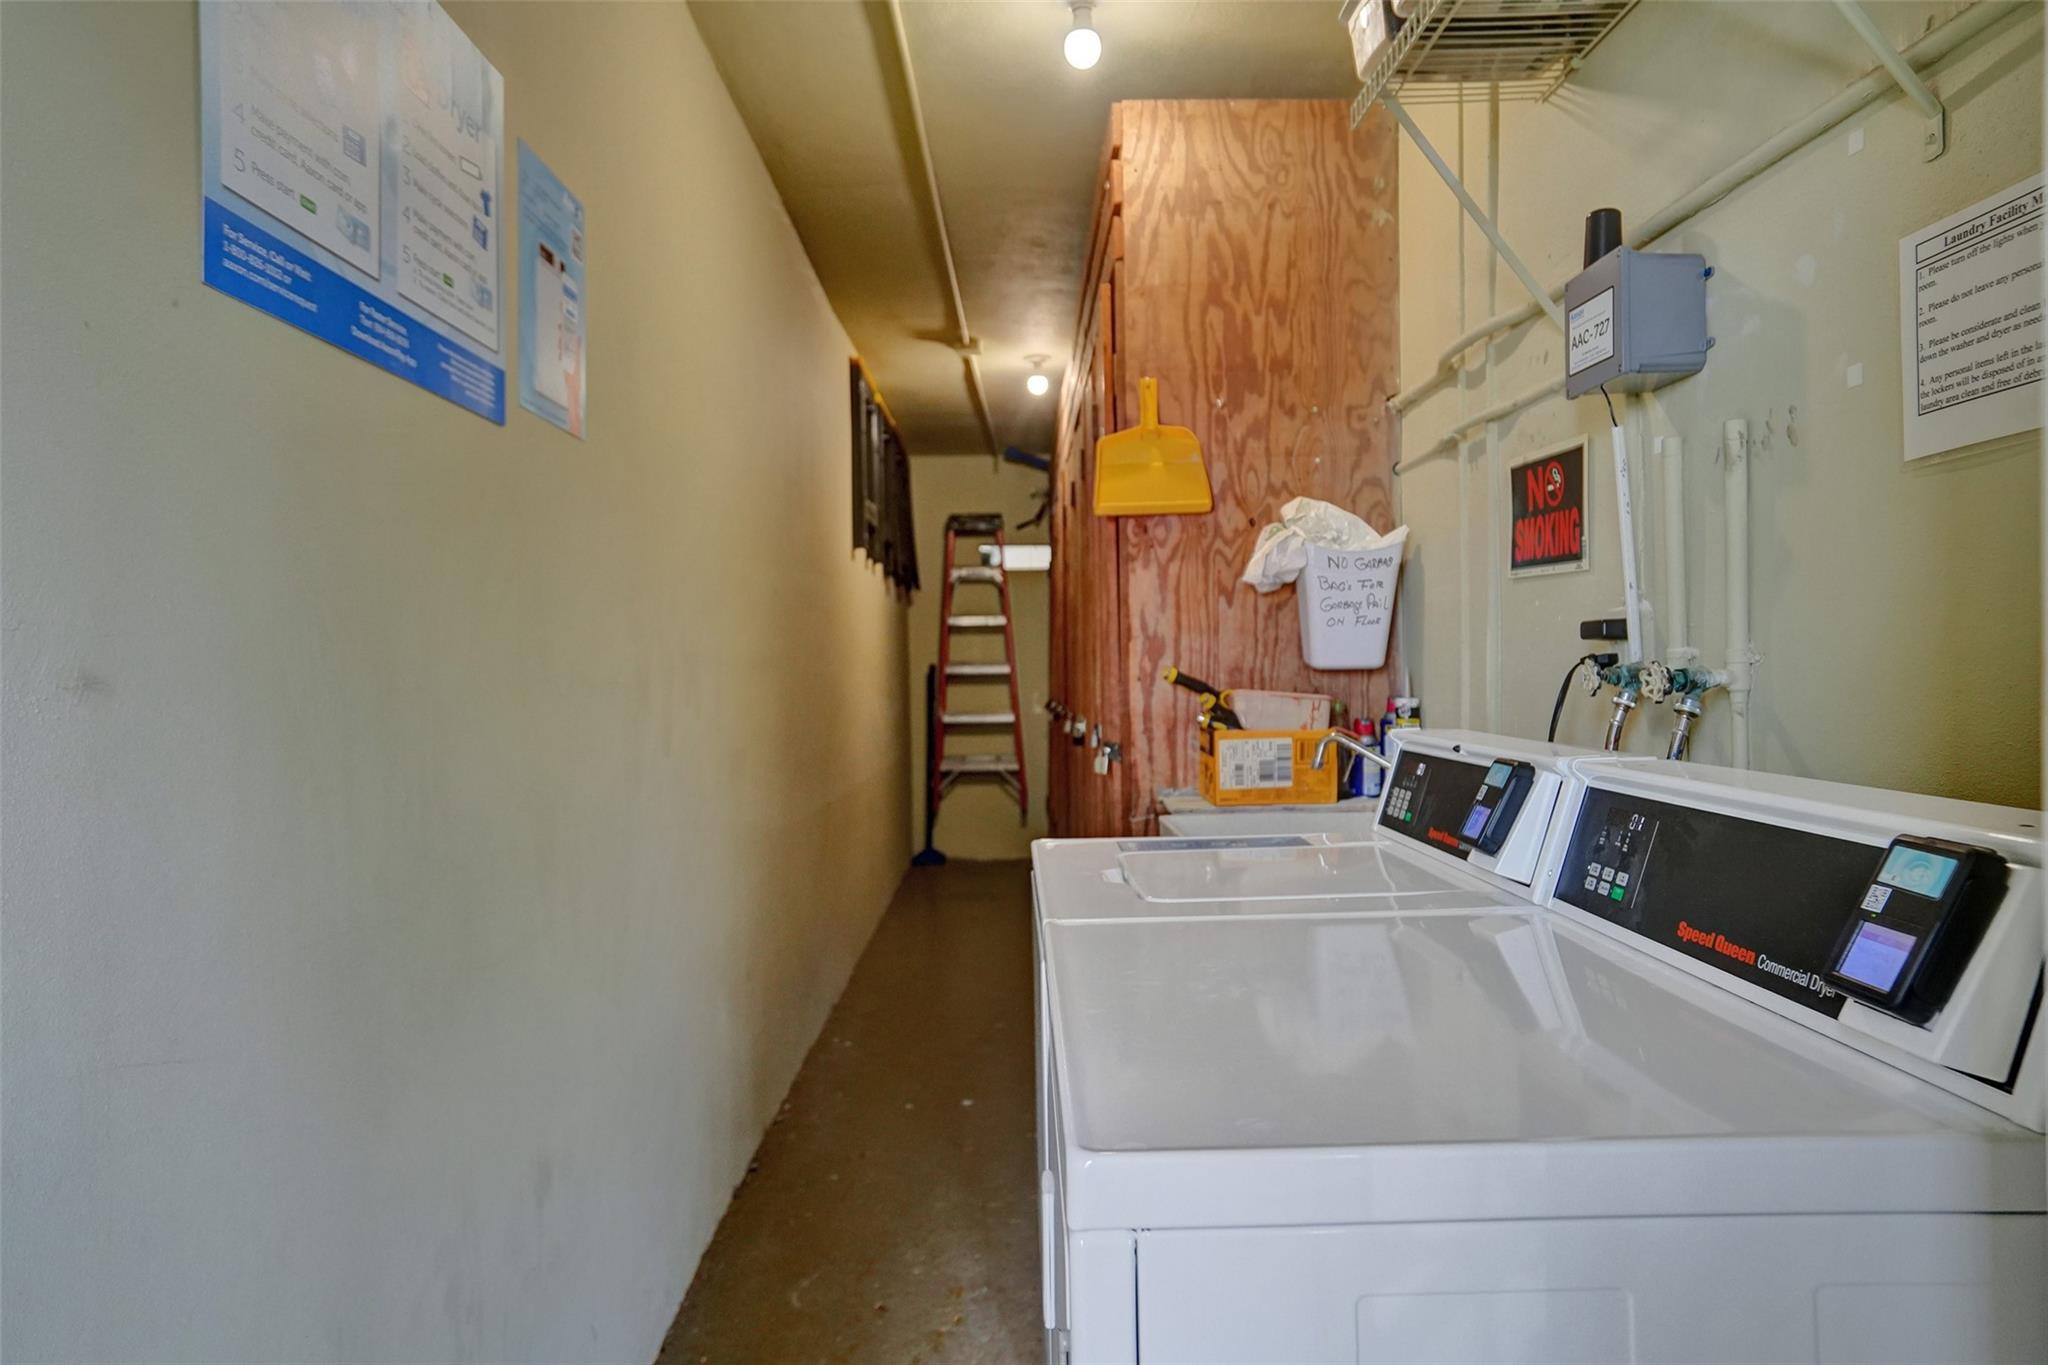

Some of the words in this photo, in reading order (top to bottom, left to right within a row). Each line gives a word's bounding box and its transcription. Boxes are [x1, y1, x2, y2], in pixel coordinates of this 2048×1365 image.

[1944, 221, 1986, 247] Laundry
[1989, 201, 2029, 226] Facility
[1928, 262, 1949, 276] Please
[1951, 255, 1965, 266] turn
[1967, 246, 1979, 259] off
[1979, 242, 1991, 254] the
[1993, 234, 2014, 248] lights
[2016, 223, 2039, 237] when
[1928, 299, 1949, 313] Please
[1951, 294, 1960, 303] do
[1961, 288, 1973, 299] not
[1974, 281, 1994, 294] leave
[1995, 275, 2008, 285] any
[2011, 262, 2043, 281] persona
[1571, 317, 1610, 351] AAC-727
[1920, 351, 1937, 363] down
[1938, 347, 1949, 357] the
[1950, 339, 1975, 352] washer
[1975, 331, 1990, 344] and
[1991, 326, 2012, 338] dryer
[2012, 322, 2021, 331] as
[1928, 335, 1949, 349] Please
[1951, 331, 1959, 340] be
[1961, 316, 2002, 337] considerate
[2003, 308, 2018, 321] and
[2019, 302, 2041, 316] clean
[1920, 389, 1930, 399] the
[1931, 382, 1954, 396] lockers
[1955, 376, 1969, 387] will
[1970, 373, 1979, 383] be
[1981, 362, 2015, 380] disposed
[2016, 357, 2025, 369] of
[2026, 356, 2035, 366] in
[1929, 375, 1942, 385] Any
[1944, 362, 1973, 381] personal
[1975, 357, 1994, 369] items
[1996, 350, 2009, 363] left
[2011, 347, 2019, 358] in
[2020, 344, 2033, 355] the
[1920, 399, 1943, 412] laundry
[1945, 394, 1959, 404] area
[1960, 388, 1979, 399] clean
[1981, 382, 1995, 393] and
[1996, 378, 2011, 388] free
[2013, 372, 2023, 382] of
[1526, 461, 1565, 513] NO
[1515, 507, 1581, 562] SMOKING
[1327, 555, 1349, 570] NO
[1327, 616, 1345, 627] ON
[1677, 920, 1715, 949] Speed
[1715, 934, 1757, 966] Queen
[1757, 954, 1811, 986] Commercial
[1809, 974, 1837, 999] Dryer
